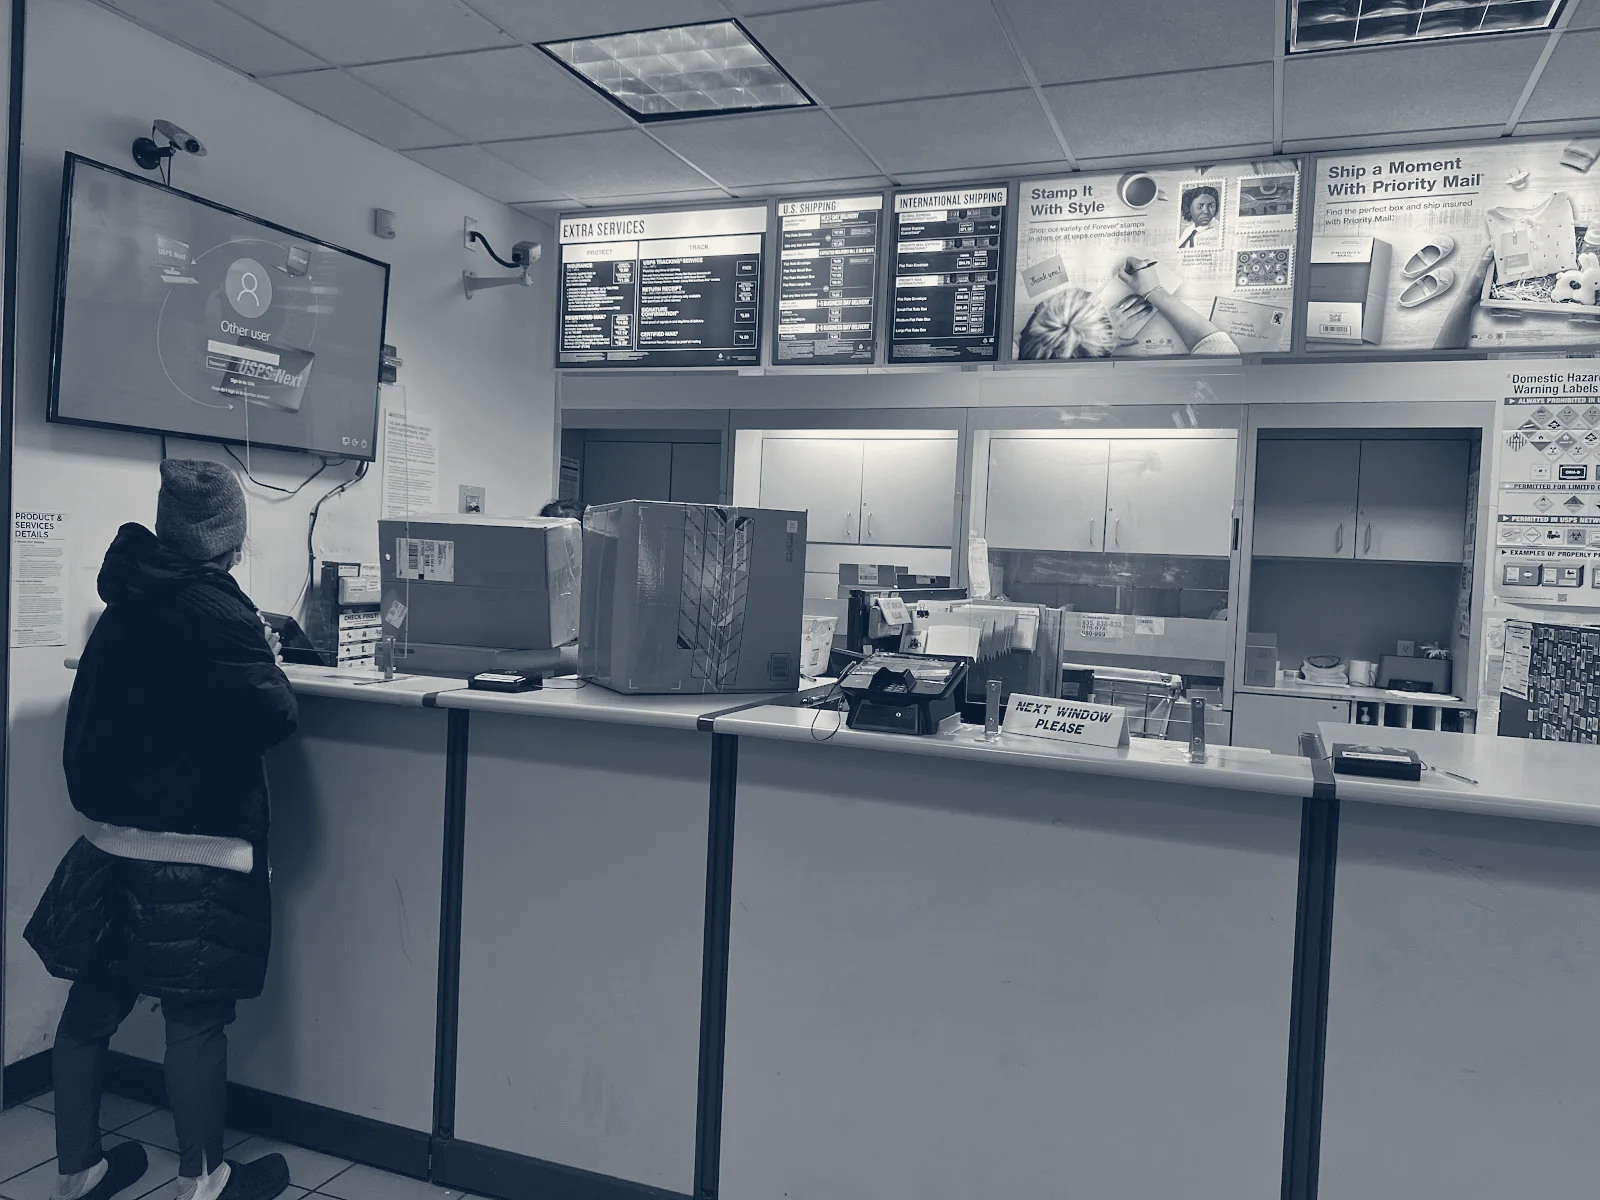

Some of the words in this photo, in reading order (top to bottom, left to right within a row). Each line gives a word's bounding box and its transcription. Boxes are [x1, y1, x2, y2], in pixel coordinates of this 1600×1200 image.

[1328, 164, 1366, 179] Ship
[1372, 165, 1382, 176] a
[1388, 157, 1462, 174] Moment
[1031, 188, 1077, 200] Stamp
[1083, 185, 1093, 197] It
[1327, 182, 1366, 196] With
[1372, 178, 1437, 193] Priority
[783, 203, 798, 214] U.S.
[800, 200, 837, 213] SHIPPING
[899, 194, 961, 209] INTERNATIONAL
[963, 192, 1003, 205] SHIPPING
[1359, 206, 1387, 215] perfect
[1389, 203, 1404, 212] box
[1405, 202, 1421, 210] and
[1423, 201, 1440, 211] ship
[1442, 199, 1473, 208] insured
[1030, 204, 1063, 216] With
[1068, 201, 1105, 215] Style
[1060, 224, 1081, 232] variety
[1120, 221, 1145, 229] stamps
[1343, 216, 1372, 225] Priority
[563, 223, 594, 238] EXTRA
[597, 220, 645, 236] SERVICES
[1071, 230, 1145, 240] usps.com/addstamps
[158, 248, 172, 258] USPS
[1029, 272, 1048, 286] Thank
[1047, 265, 1062, 281] you!
[1243, 264, 1281, 273] LOVE
[220, 320, 249, 337] Other
[250, 329, 271, 341] user
[239, 358, 274, 380] USPS
[273, 368, 303, 387] Next
[1512, 373, 1564, 384] Domestic
[1567, 373, 1600, 382] Hazar
[1513, 384, 1559, 396] Warning
[1562, 384, 1599, 394] Labels
[15, 512, 55, 521] PRODUCT
[56, 514, 63, 522] &
[15, 521, 55, 530] SERVICES
[788, 521, 796, 530] XL
[15, 530, 49, 538] DETAILS
[1015, 701, 1052, 715] NEXT
[1056, 706, 1113, 723] WINDOW
[1034, 718, 1085, 735] PLEASE
